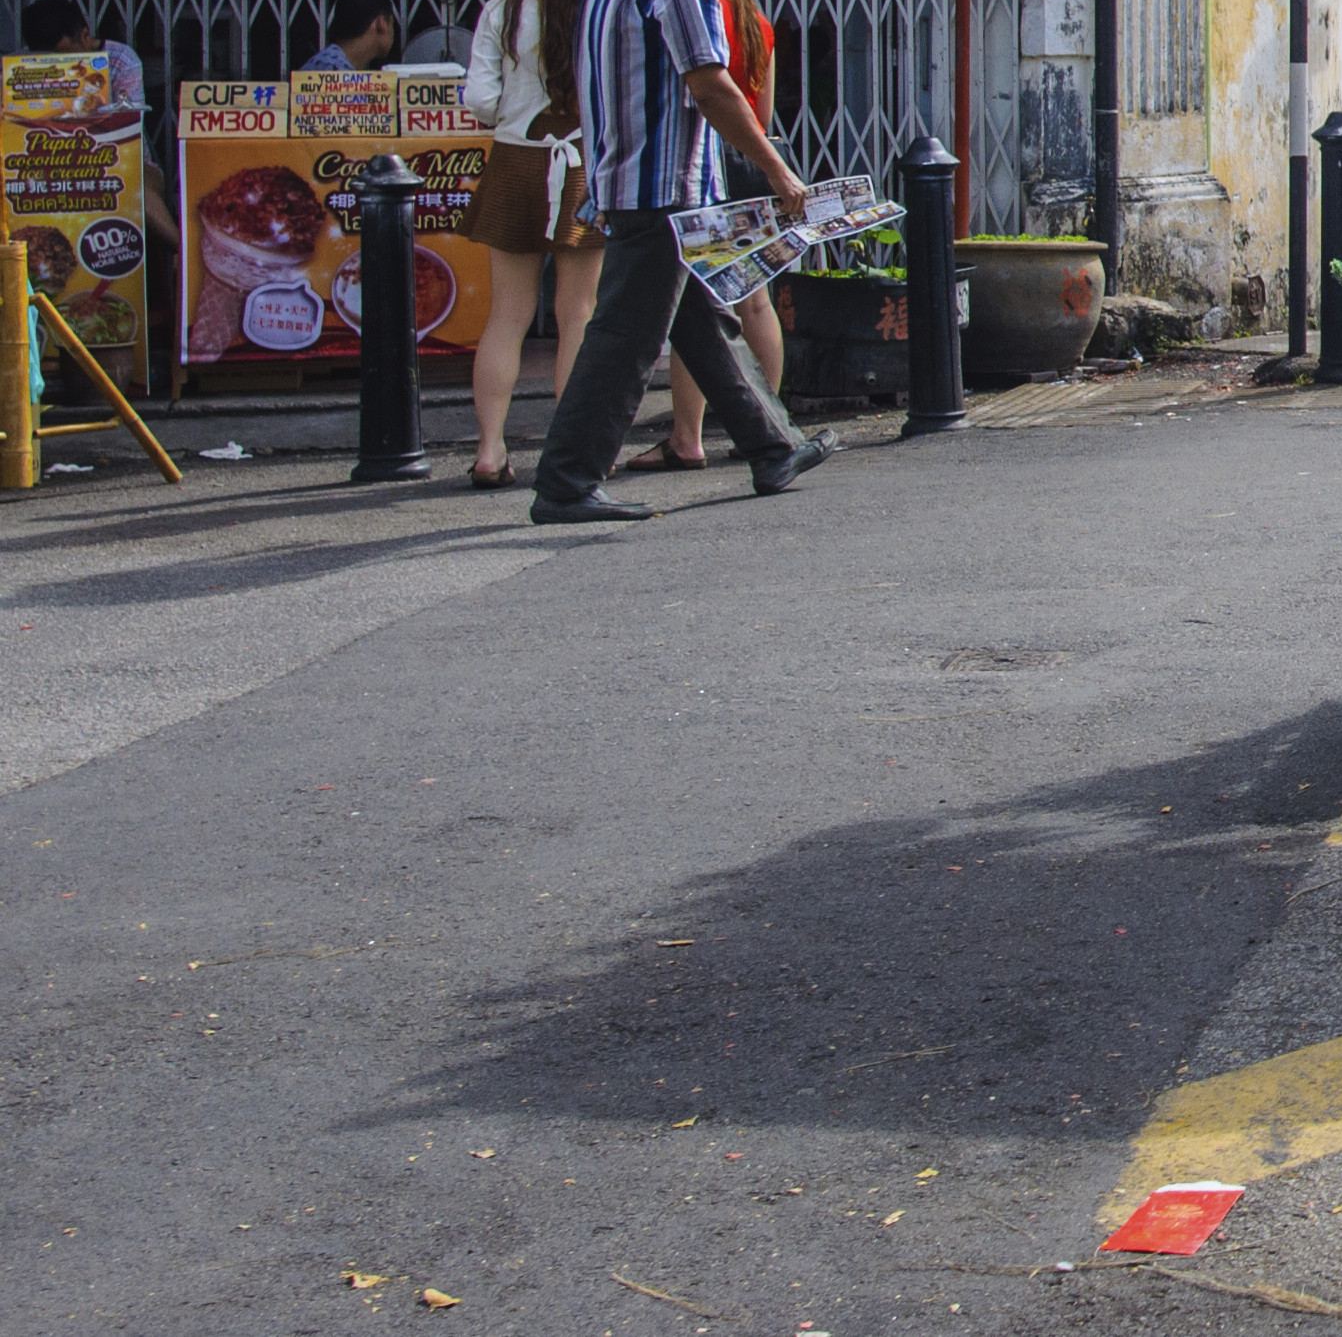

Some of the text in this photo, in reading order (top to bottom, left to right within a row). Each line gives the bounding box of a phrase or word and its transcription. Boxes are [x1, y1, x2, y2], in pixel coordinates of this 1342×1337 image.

[319, 73, 340, 83] YOU
[193, 84, 248, 106] CUP
[252, 85, 277, 106] 杯
[301, 83, 388, 92] BUY HAPPINESS
[406, 85, 455, 105] CONE
[295, 94, 391, 104] BUT YOU CAN BUY
[302, 104, 389, 114] ICE CREAM
[294, 115, 315, 125] AND
[353, 115, 379, 125] KIND
[380, 115, 395, 124] OF
[297, 125, 391, 135] THE SAME THING
[28, 130, 92, 154] Papa's
[8, 148, 114, 168] coconut milk
[427, 151, 484, 175] Milk
[21, 165, 100, 179] ice cream
[84, 227, 138, 253] 100%
[91, 250, 141, 269] HOME MADE
[97, 245, 130, 259] NATURAL
